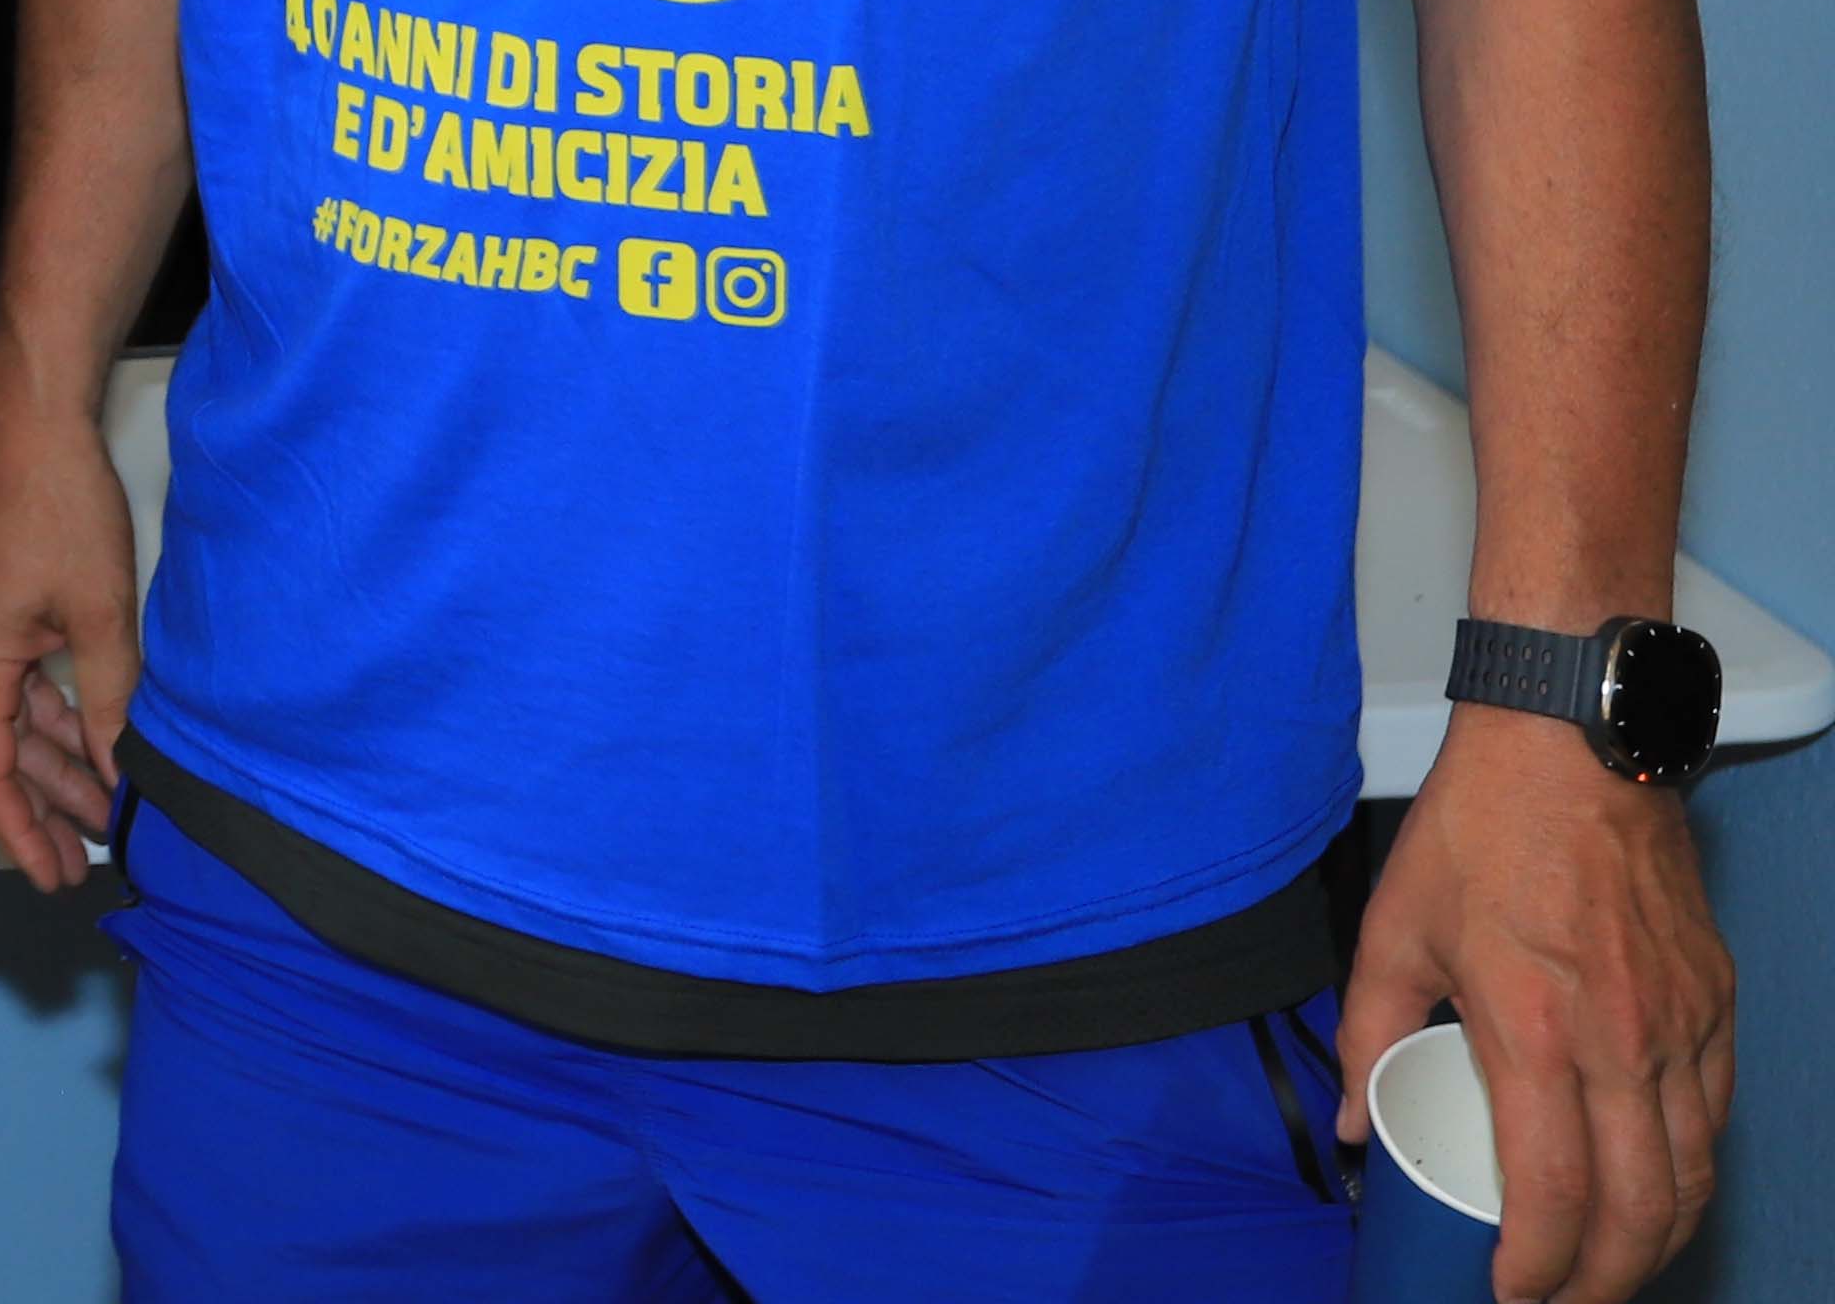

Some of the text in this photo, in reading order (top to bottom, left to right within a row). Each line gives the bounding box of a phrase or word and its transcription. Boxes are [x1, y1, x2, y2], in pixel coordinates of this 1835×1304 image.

[339, 1, 478, 99] ANNI
[487, 32, 559, 113] DI
[575, 44, 871, 137] STORIA
[333, 83, 768, 217] E D'AMICIZIA
[311, 196, 598, 299] #FORZAHBC
